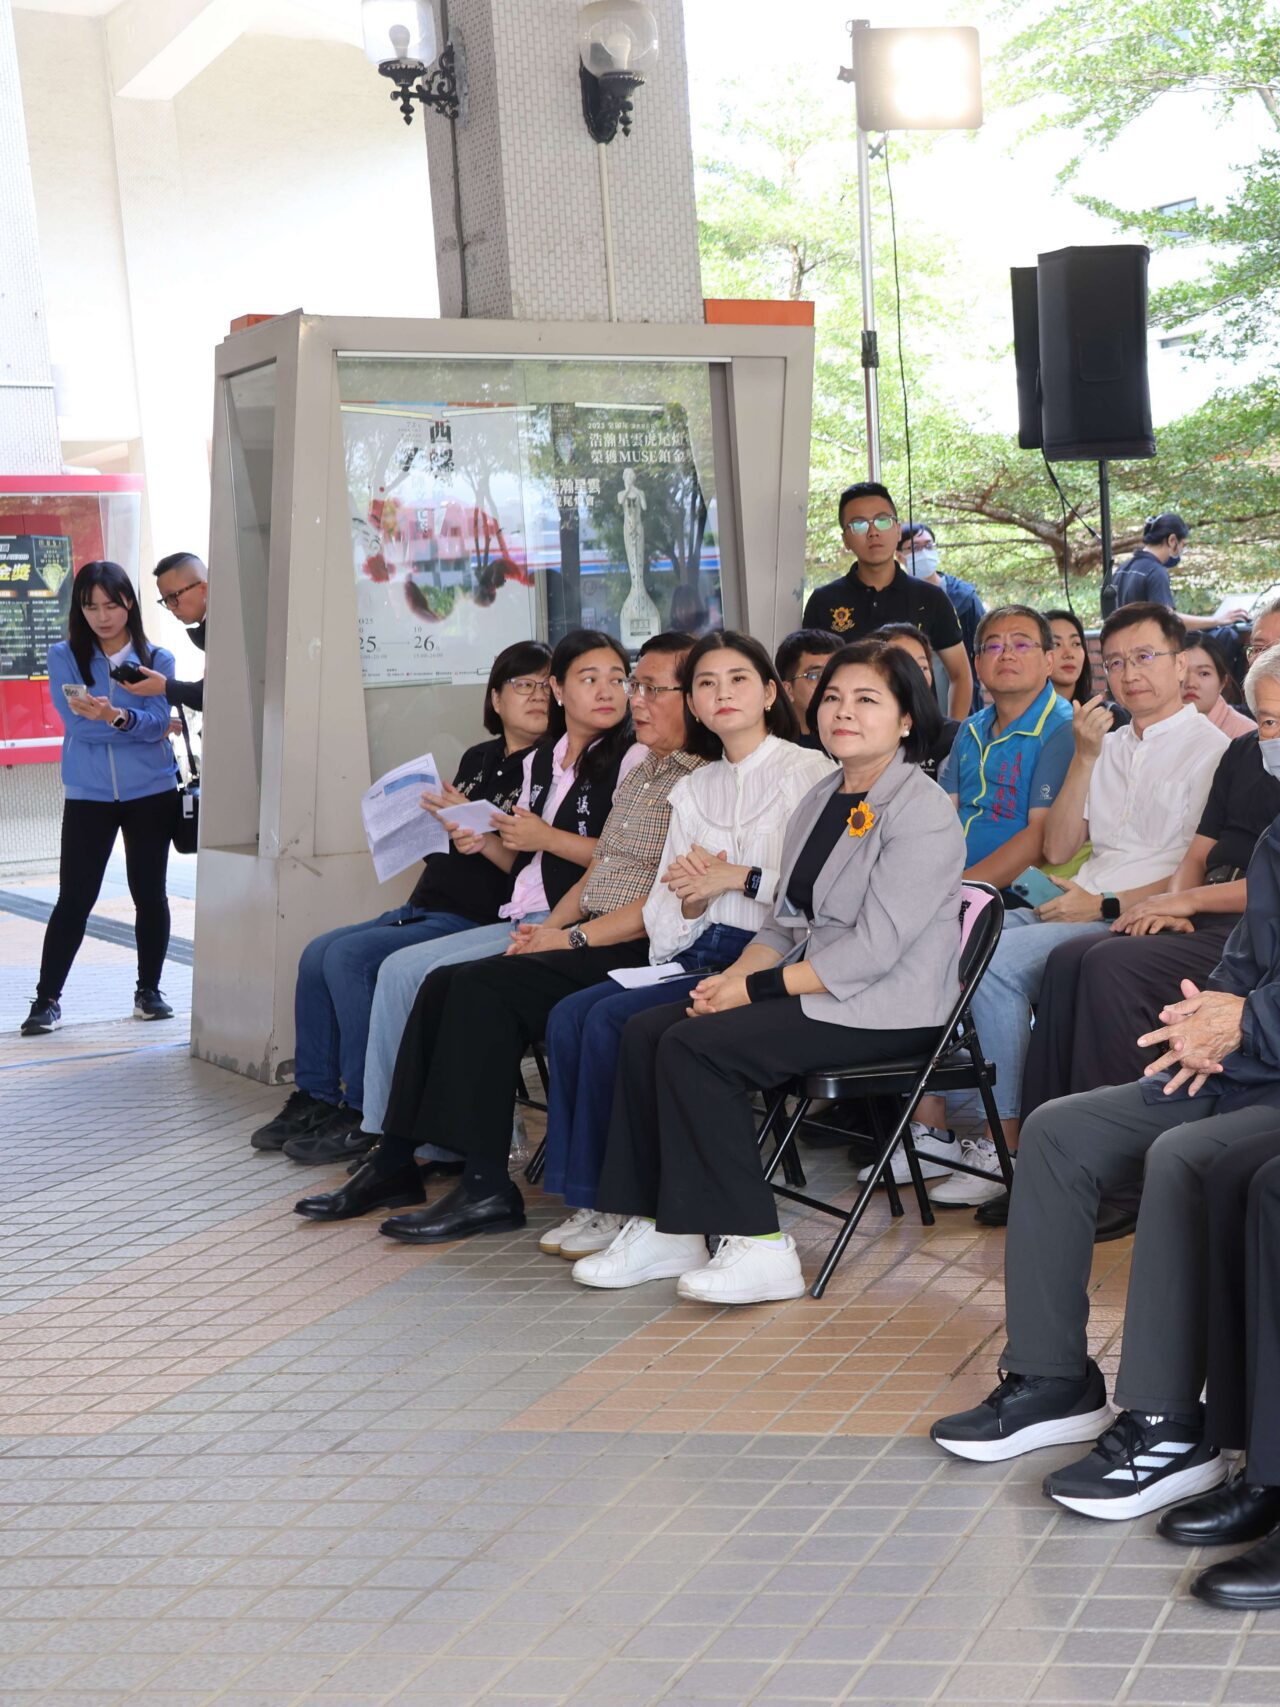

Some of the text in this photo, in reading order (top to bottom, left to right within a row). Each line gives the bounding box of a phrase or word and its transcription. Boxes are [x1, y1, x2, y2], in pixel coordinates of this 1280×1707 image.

[589, 431, 690, 447] 浩瀚星雲虎尾燈
[414, 635, 435, 652] 26
